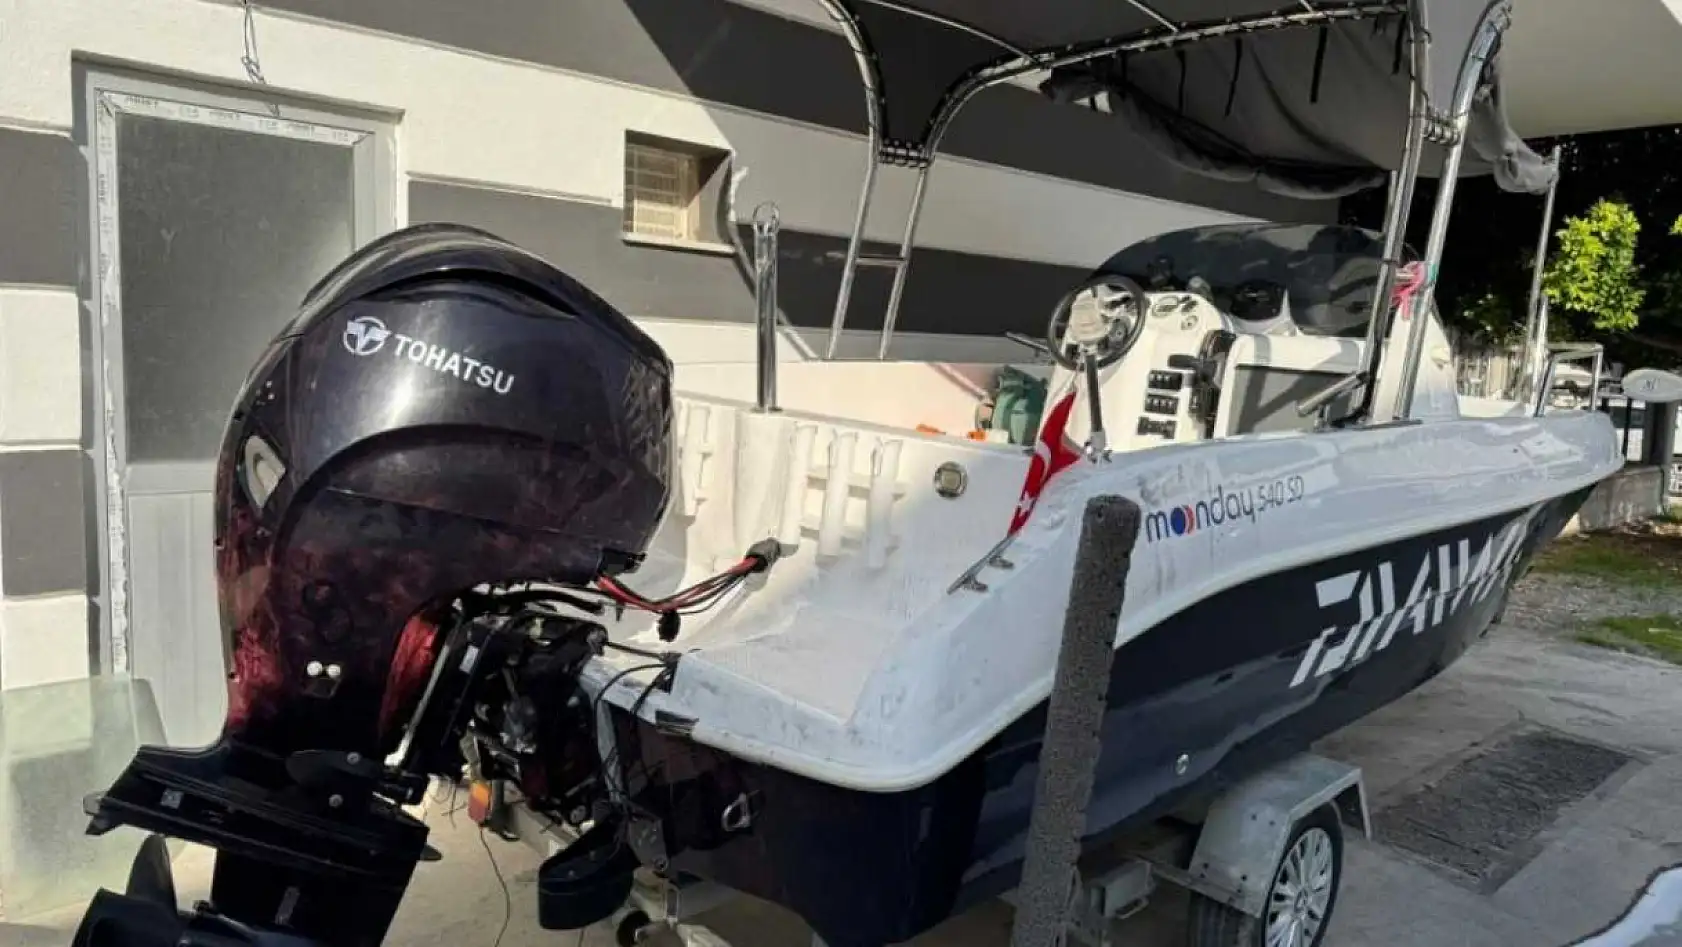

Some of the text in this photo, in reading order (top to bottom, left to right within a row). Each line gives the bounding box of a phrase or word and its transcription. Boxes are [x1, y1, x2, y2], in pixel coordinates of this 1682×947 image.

[394, 333, 515, 394] TOHATSU
[1258, 481, 1284, 512] 540
[1287, 475, 1305, 503] SD
